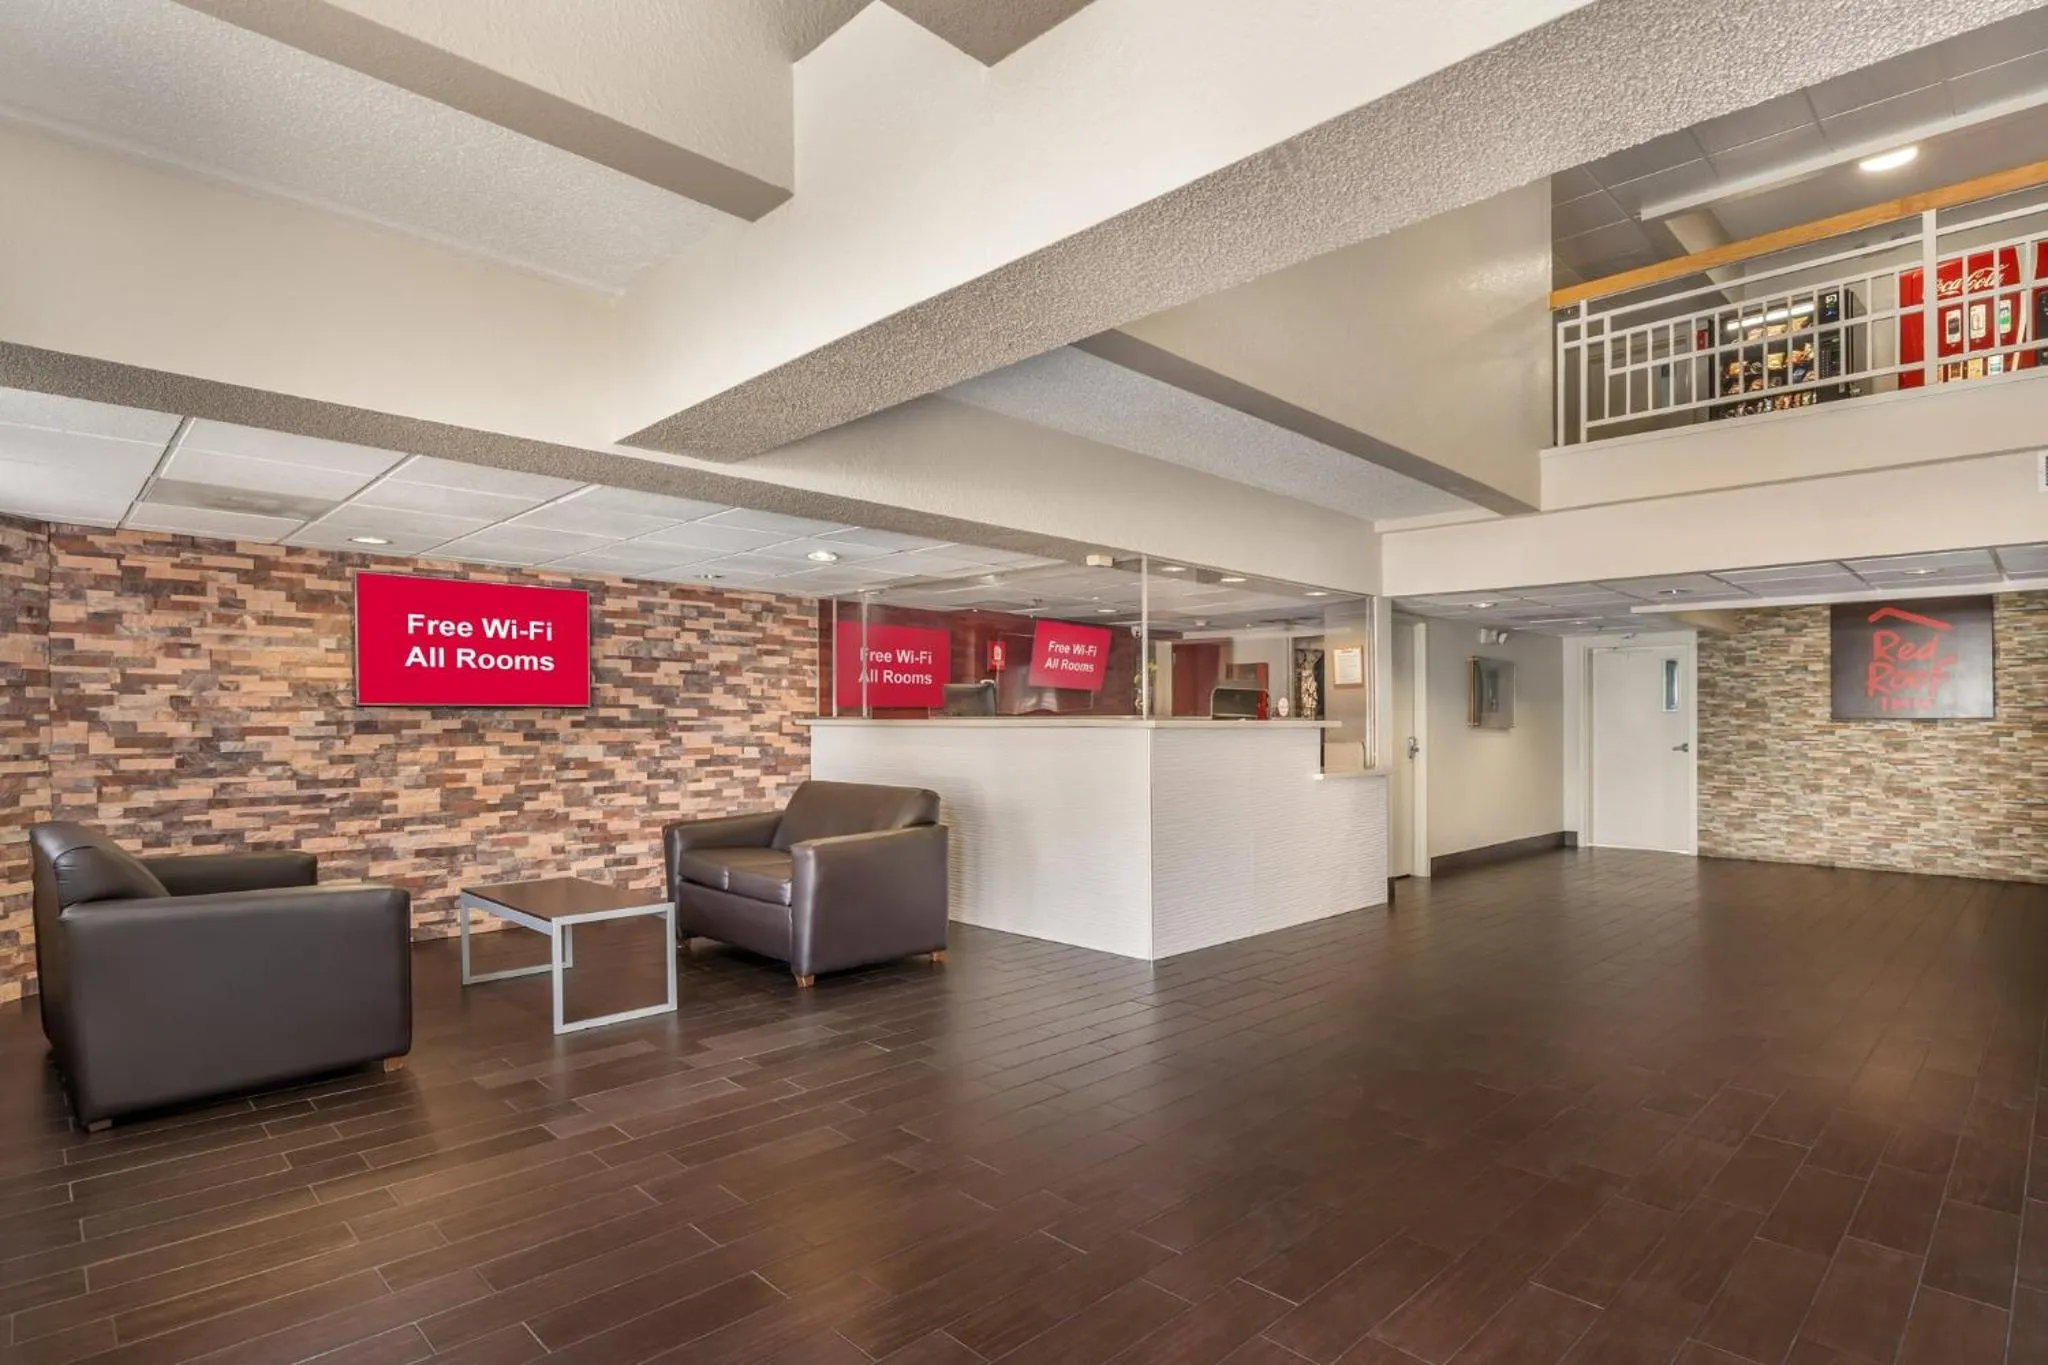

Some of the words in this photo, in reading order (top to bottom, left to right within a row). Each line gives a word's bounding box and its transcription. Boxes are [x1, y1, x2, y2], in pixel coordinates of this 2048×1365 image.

[407, 613, 474, 637] Free
[481, 618, 553, 641] Wi-Fi
[860, 647, 893, 663] Free
[896, 649, 933, 665] Wi-Fi
[1048, 640, 1070, 654] Free
[1072, 643, 1097, 657] Wi-Fi
[1872, 629, 1939, 663] Red
[404, 646, 445, 668] All
[456, 648, 555, 671] Rooms
[1044, 657, 1060, 670] All
[1061, 658, 1095, 673] Rooms
[858, 665, 879, 683] All
[883, 669, 933, 685] Rooms
[1866, 656, 1957, 698] Roof
